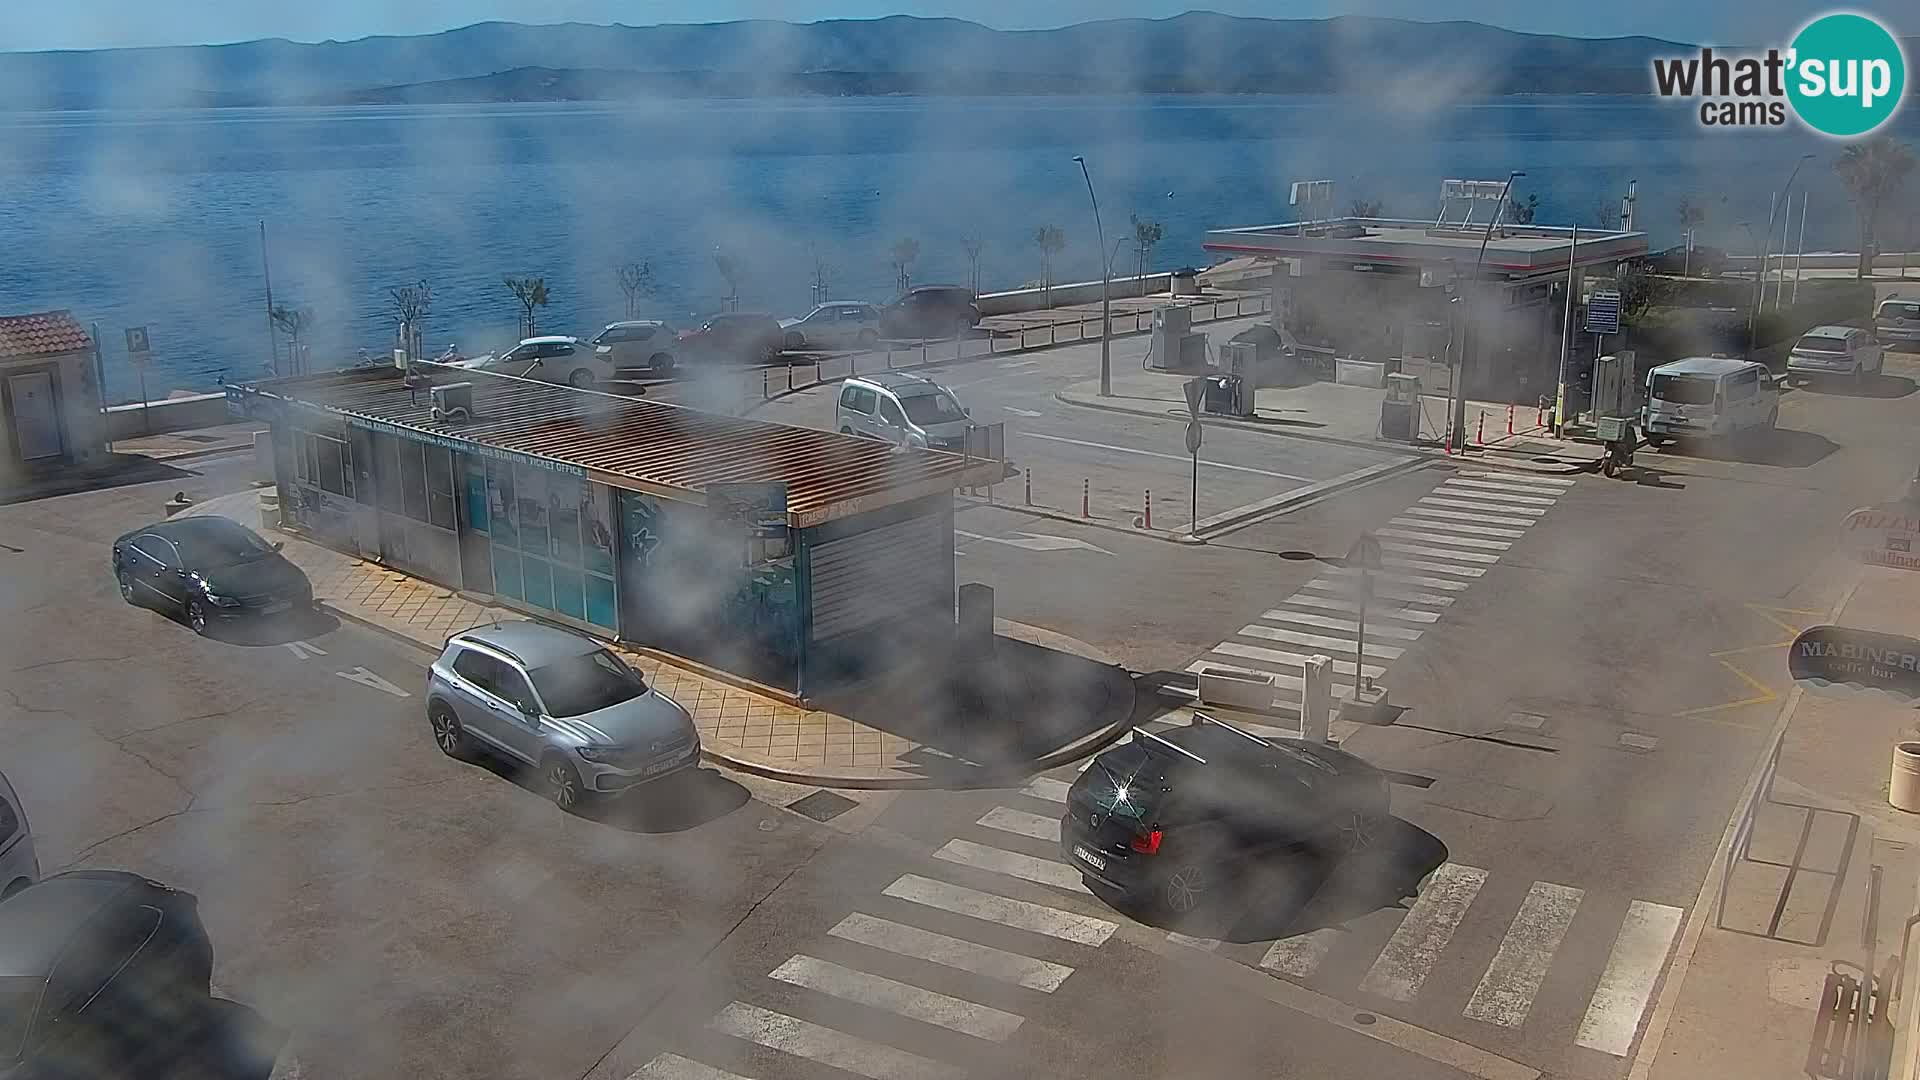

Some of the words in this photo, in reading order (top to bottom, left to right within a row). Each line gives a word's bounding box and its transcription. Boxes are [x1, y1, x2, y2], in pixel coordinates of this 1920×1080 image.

[494, 449, 527, 465] STATION
[529, 456, 555, 470] TICKET
[556, 462, 583, 477] OFFICE
